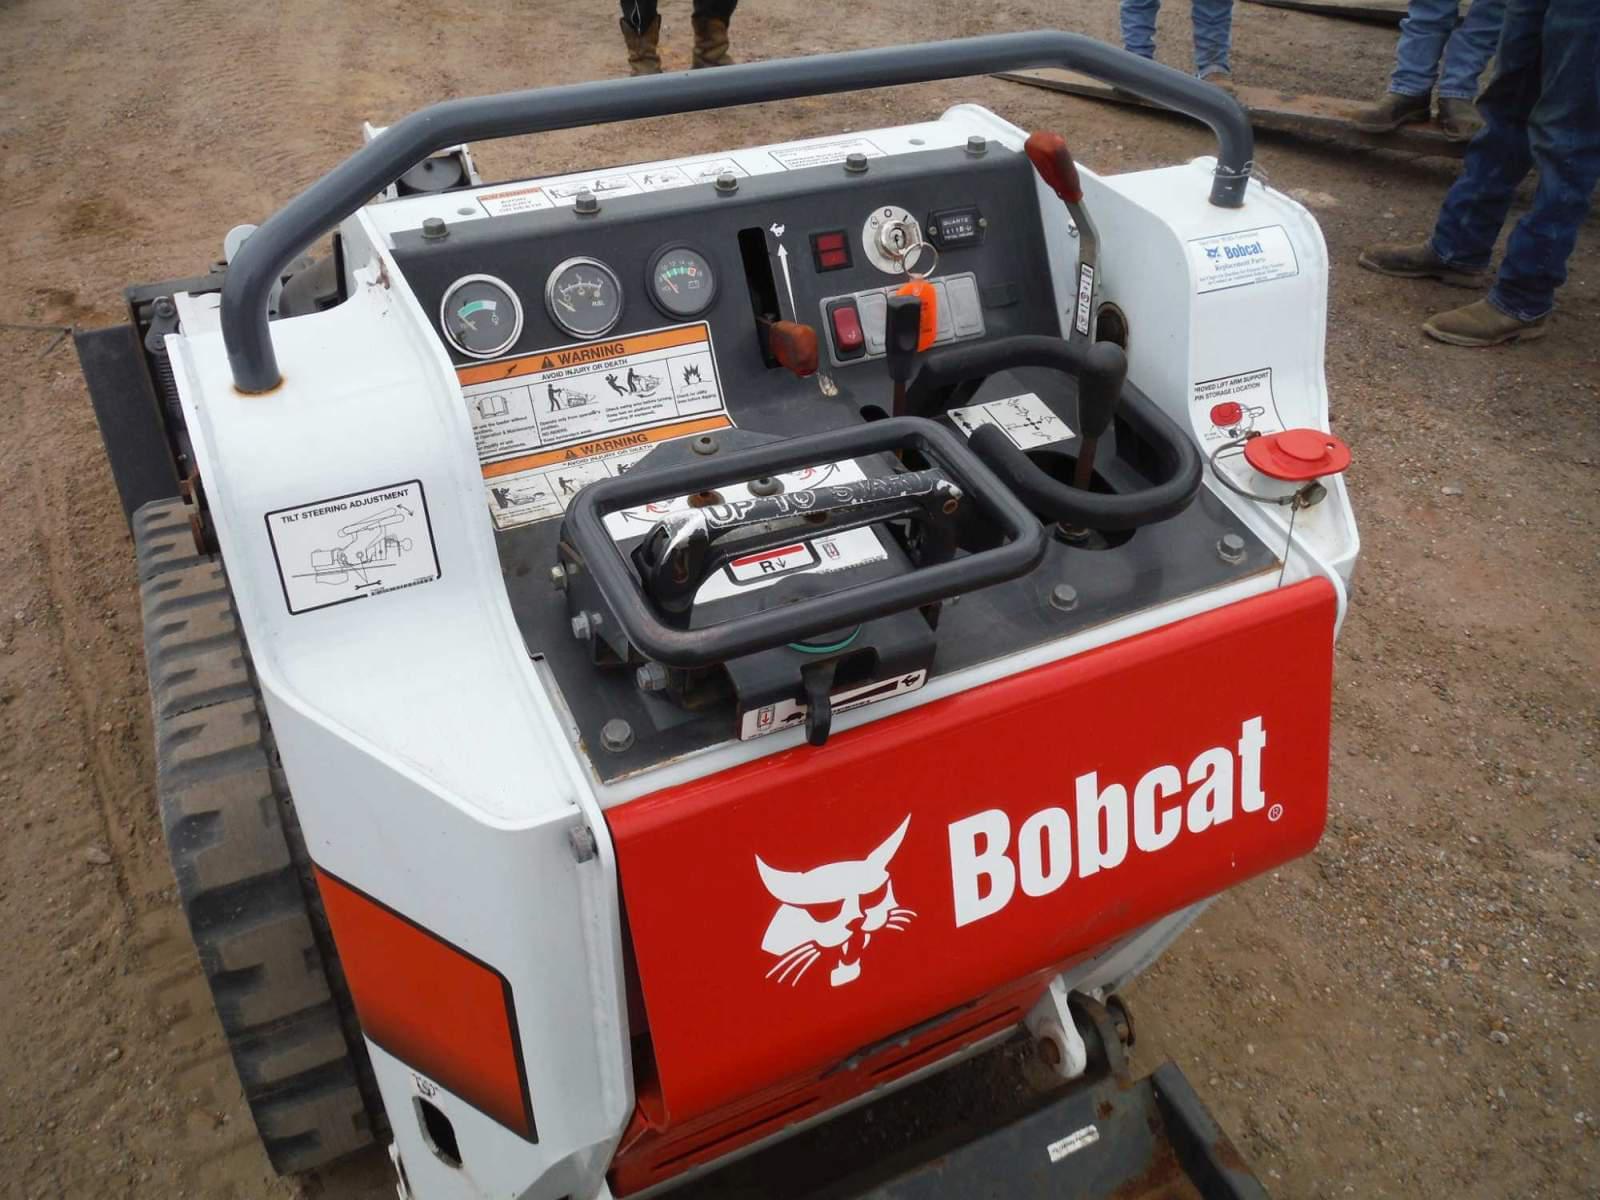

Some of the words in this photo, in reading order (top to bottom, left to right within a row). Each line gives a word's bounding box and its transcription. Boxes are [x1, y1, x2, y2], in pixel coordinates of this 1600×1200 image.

[1224, 240, 1263, 259] Bobcat
[557, 343, 625, 365] WARNING
[542, 371, 564, 380] AVOID
[565, 366, 590, 376] INJURY
[604, 359, 628, 368] DEATH
[581, 433, 648, 454] WARNING
[567, 458, 589, 466] AVOID
[281, 512, 299, 524] TILT
[301, 503, 348, 520] STEERING
[350, 489, 409, 509] ADJUSTMENT
[707, 501, 754, 523] UP
[759, 560, 776, 573] R
[948, 715, 1267, 928] Bobcat
